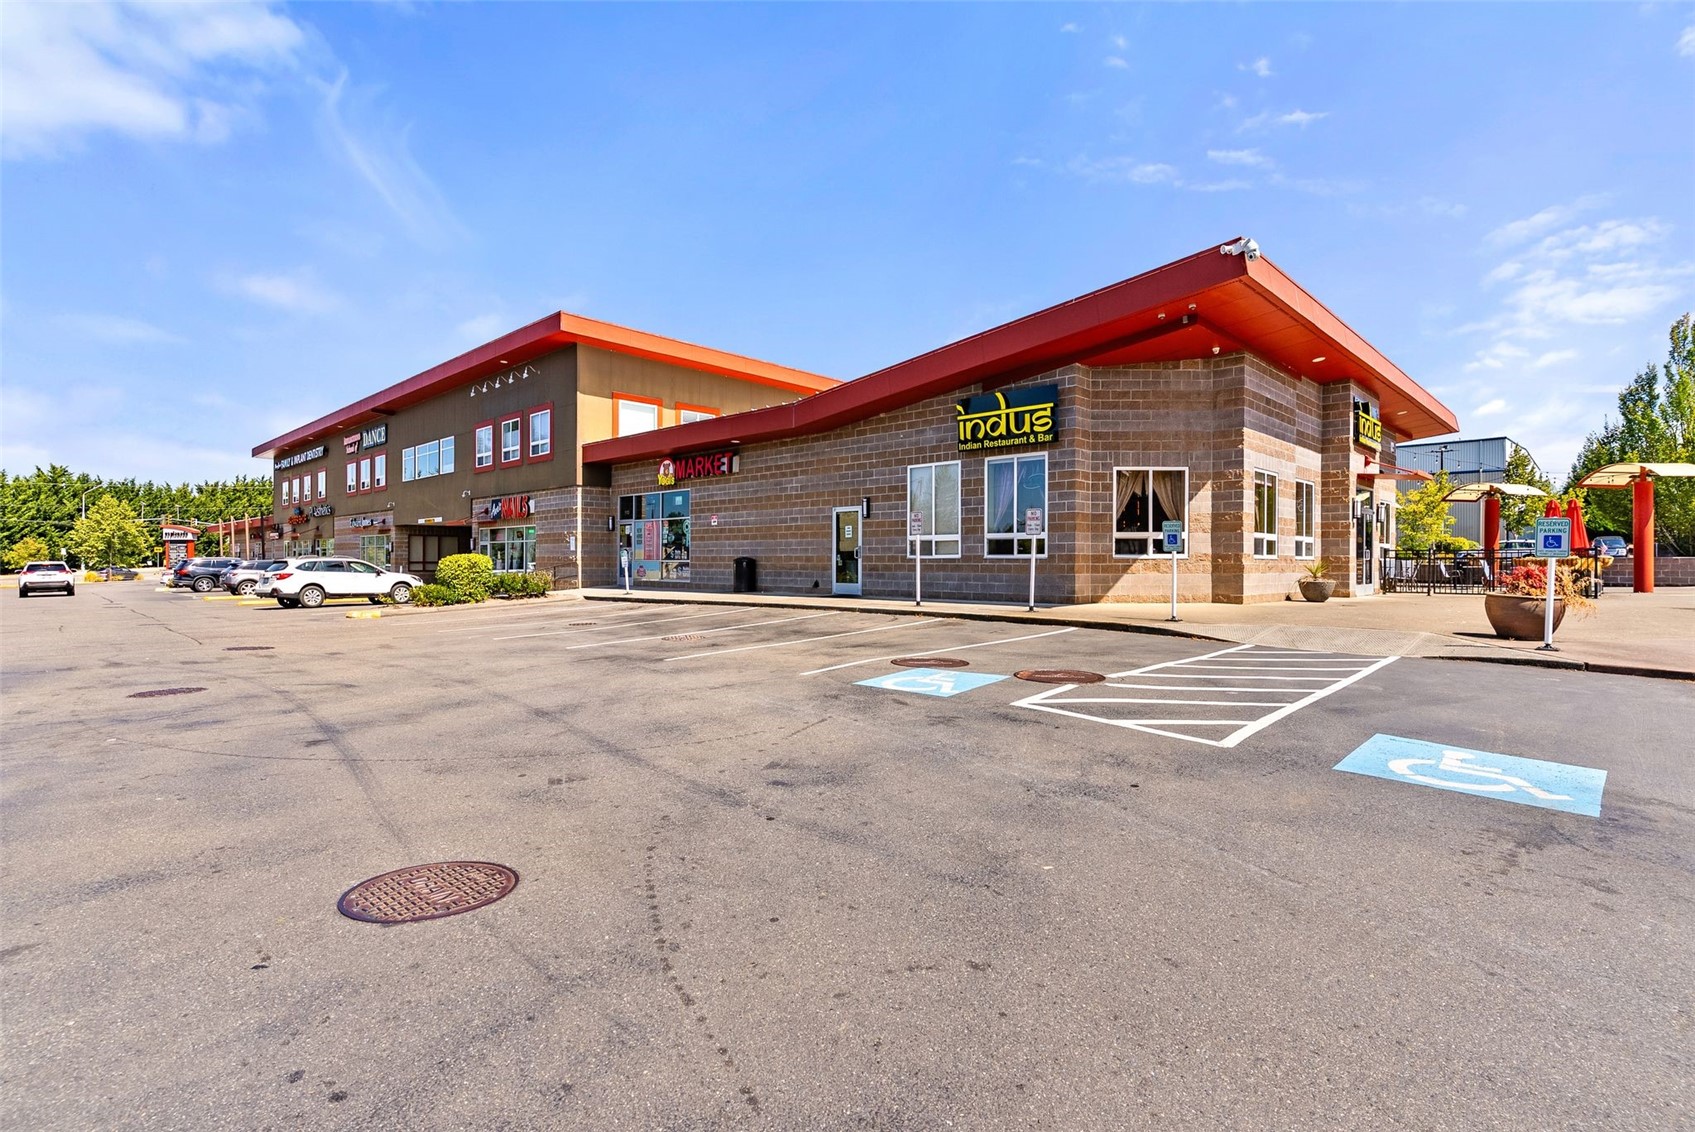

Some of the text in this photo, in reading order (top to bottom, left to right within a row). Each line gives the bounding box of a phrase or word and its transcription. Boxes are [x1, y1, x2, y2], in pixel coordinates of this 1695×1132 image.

[956, 392, 1054, 440] indus
[1359, 402, 1382, 442] indus
[363, 427, 386, 447] DANCE
[959, 433, 1053, 451] Indian Restaurant & Bar
[676, 452, 733, 479] MARKET
[501, 495, 529, 519] NAILS
